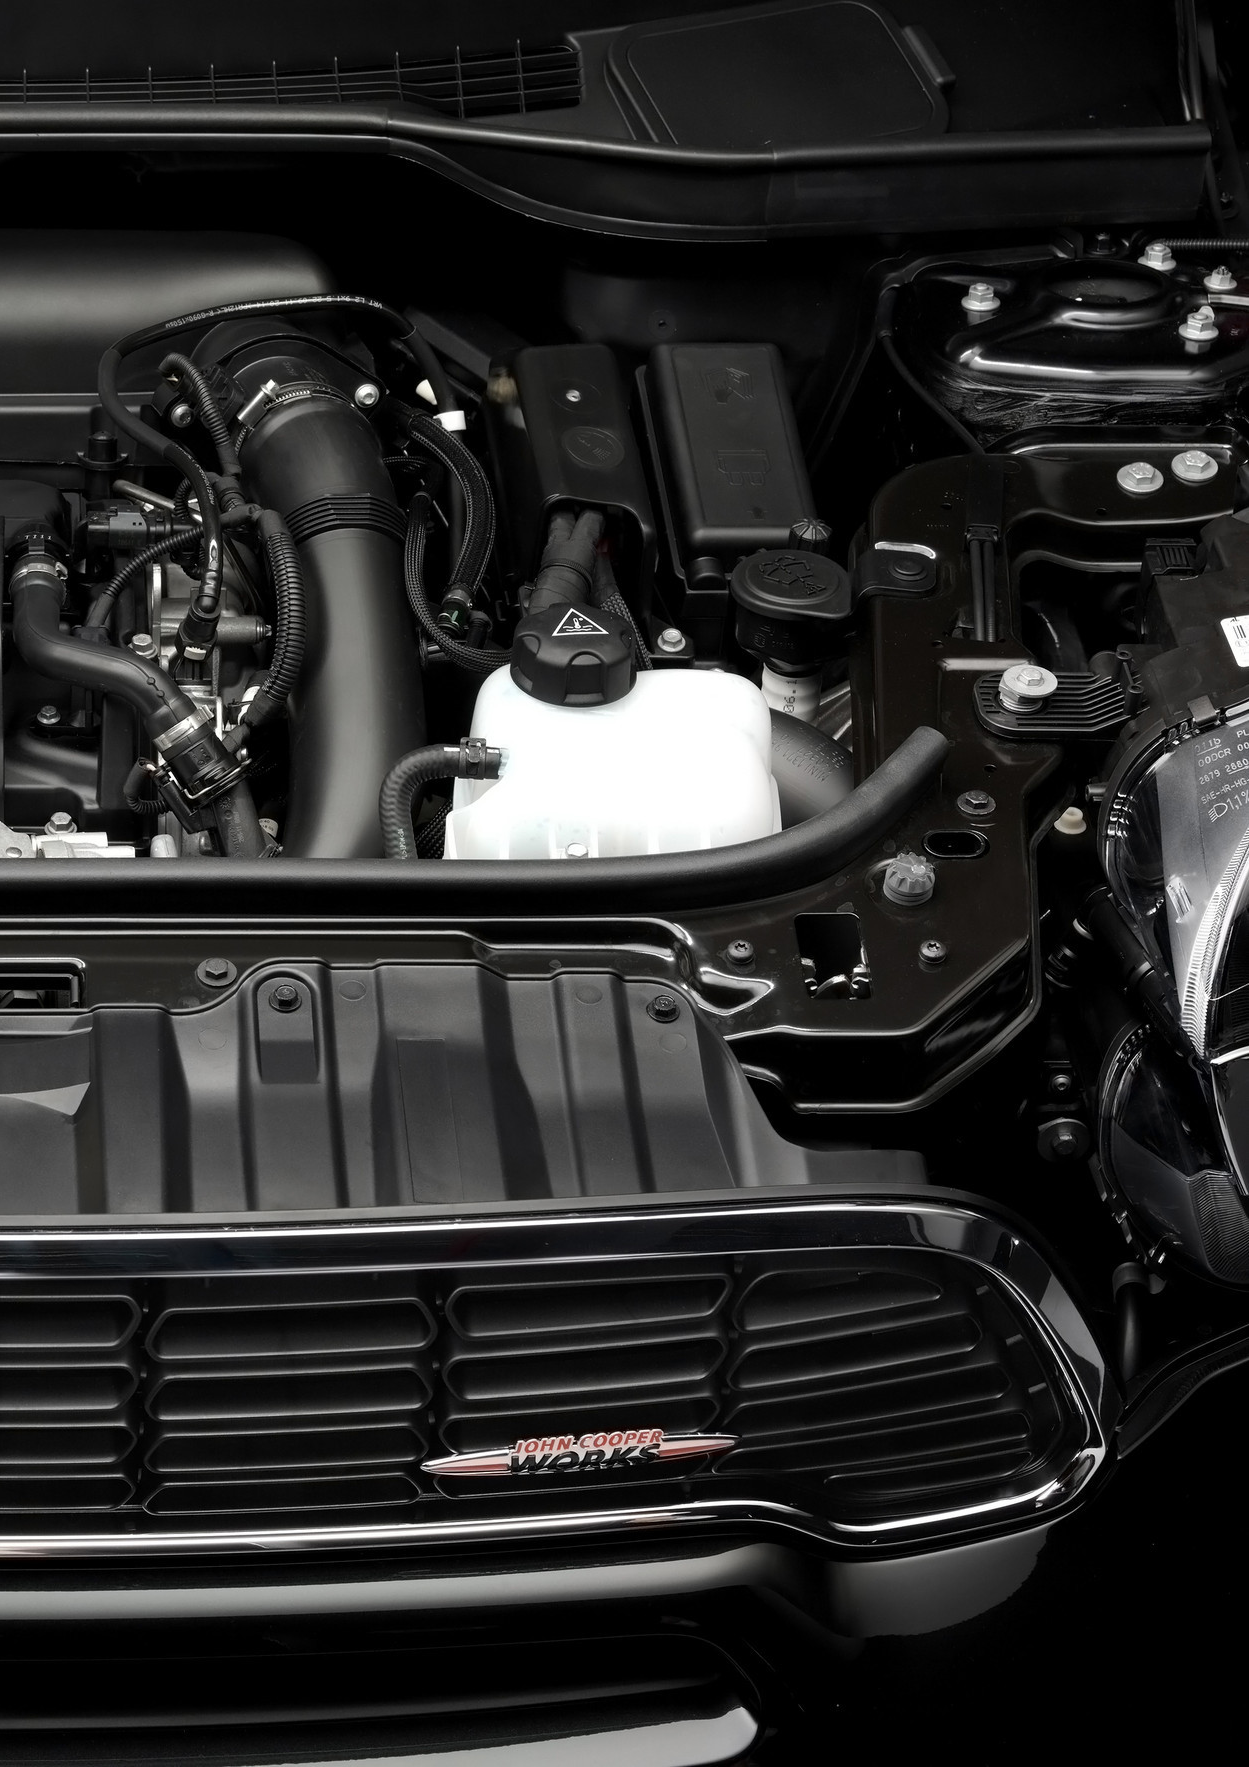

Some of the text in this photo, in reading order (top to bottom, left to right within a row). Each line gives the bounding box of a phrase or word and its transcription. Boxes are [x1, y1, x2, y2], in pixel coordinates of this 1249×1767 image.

[514, 1429, 665, 1455] JOHN COOPER
[510, 1443, 663, 1473] WORKS
